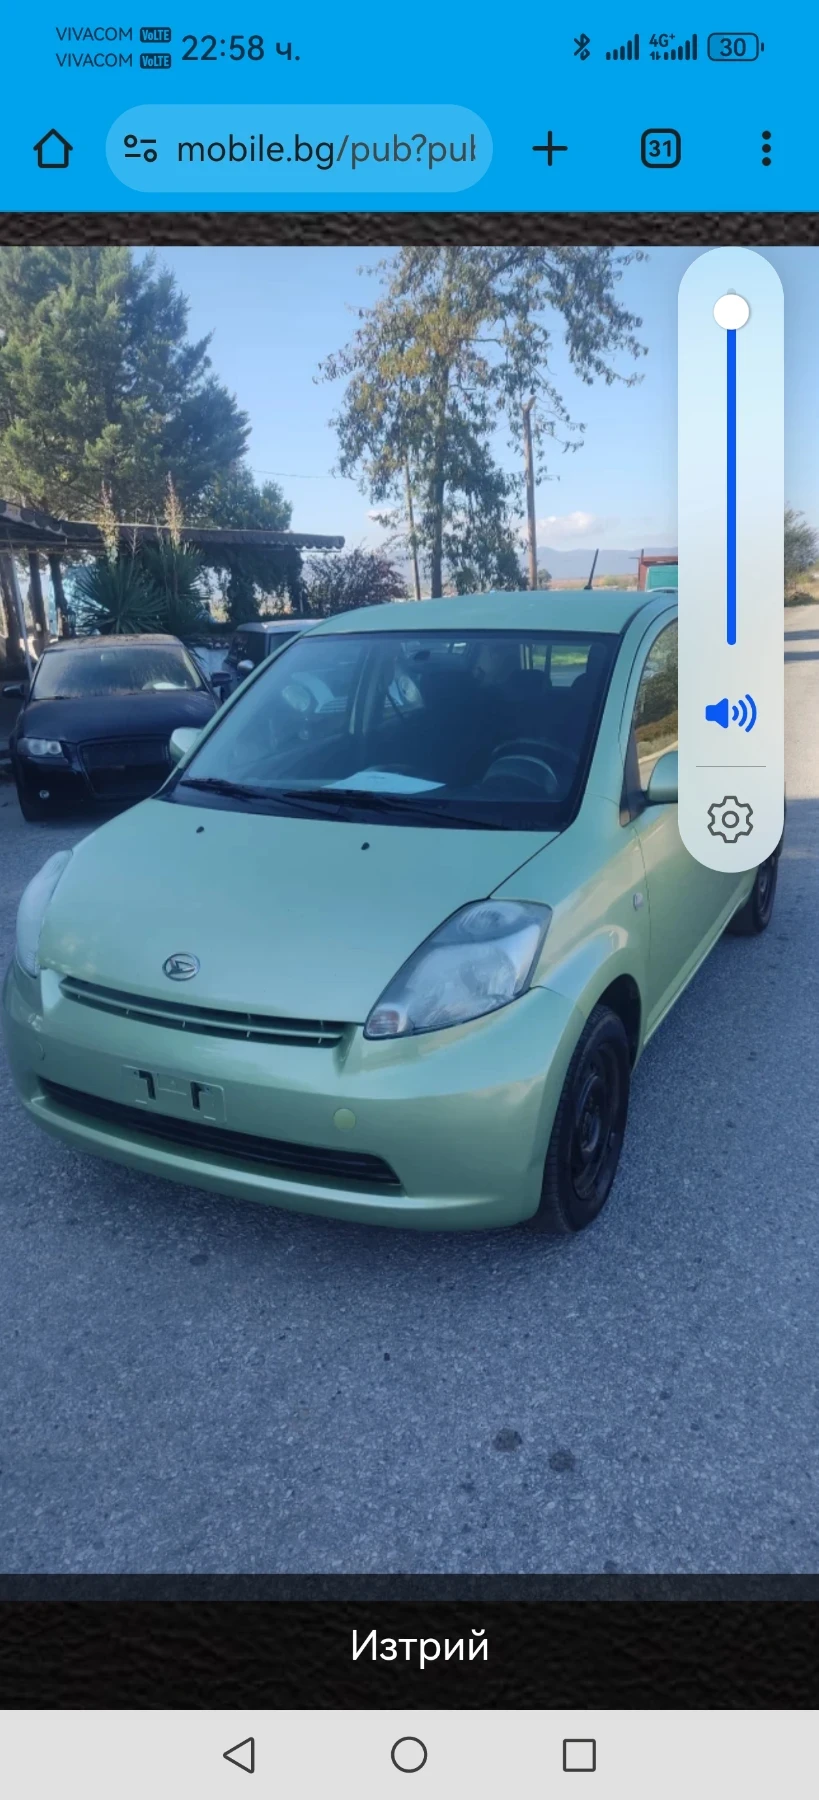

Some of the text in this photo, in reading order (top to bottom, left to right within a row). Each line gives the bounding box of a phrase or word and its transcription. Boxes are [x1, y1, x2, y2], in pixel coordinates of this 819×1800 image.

[55, 27, 170, 42] VIVACOM VoLTE
[181, 34, 265, 61] 22:58
[719, 37, 747, 57] 30
[55, 53, 170, 68] VIVACOM VoLTE
[648, 139, 672, 158] 31
[352, 1628, 489, 1670] Изтрий
